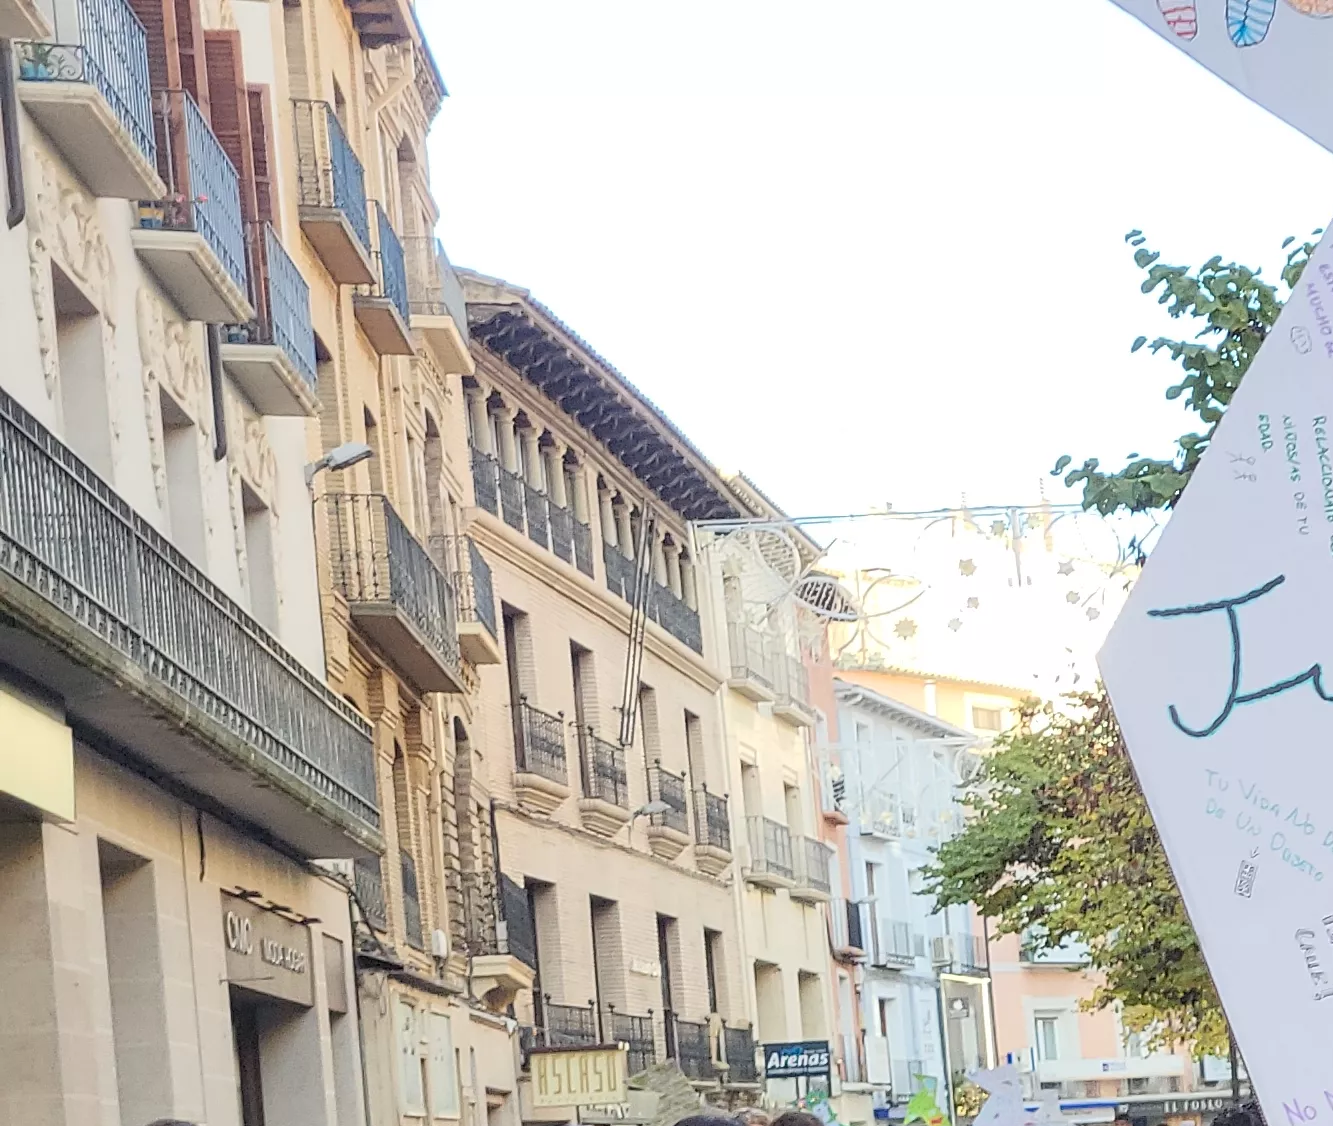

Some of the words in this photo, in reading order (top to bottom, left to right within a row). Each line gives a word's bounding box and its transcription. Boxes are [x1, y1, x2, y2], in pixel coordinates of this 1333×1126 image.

[1305, 282, 1333, 337] MUCHO
[537, 1053, 618, 1096] ASCASO
[767, 1050, 830, 1069] Arenas
